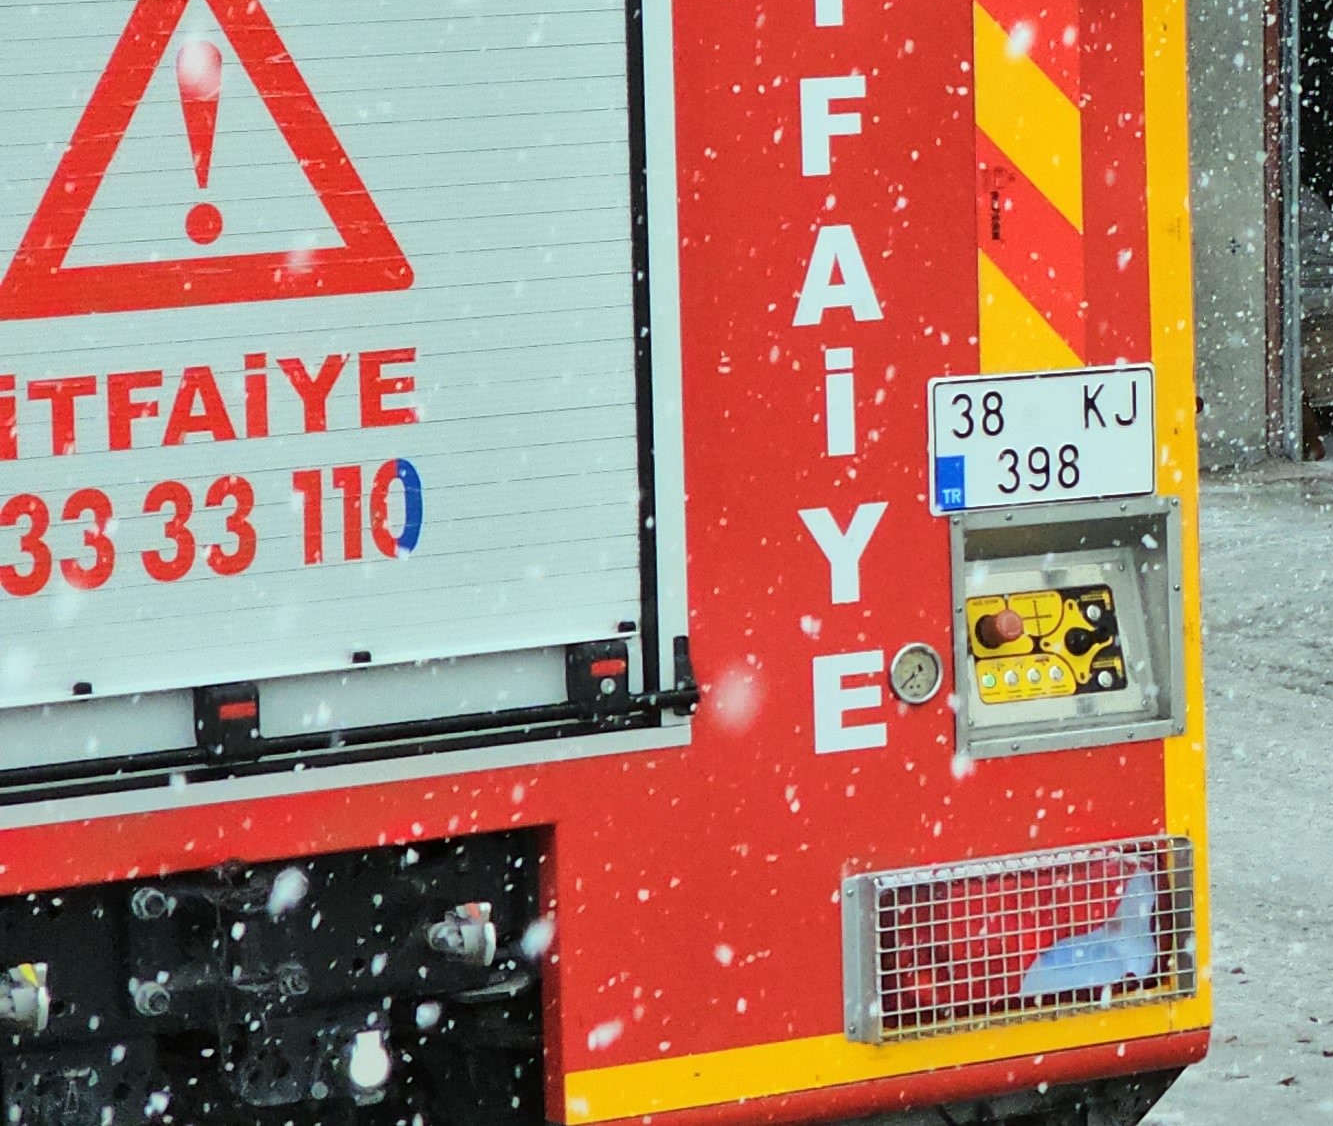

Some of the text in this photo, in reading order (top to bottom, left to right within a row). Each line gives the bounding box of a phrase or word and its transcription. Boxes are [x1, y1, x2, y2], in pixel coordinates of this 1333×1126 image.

[951, 380, 1137, 439] 38 KJ
[942, 488, 962, 504] TR
[997, 443, 1080, 494] 398
[141, 474, 258, 582] 33
[292, 457, 424, 566] 110
